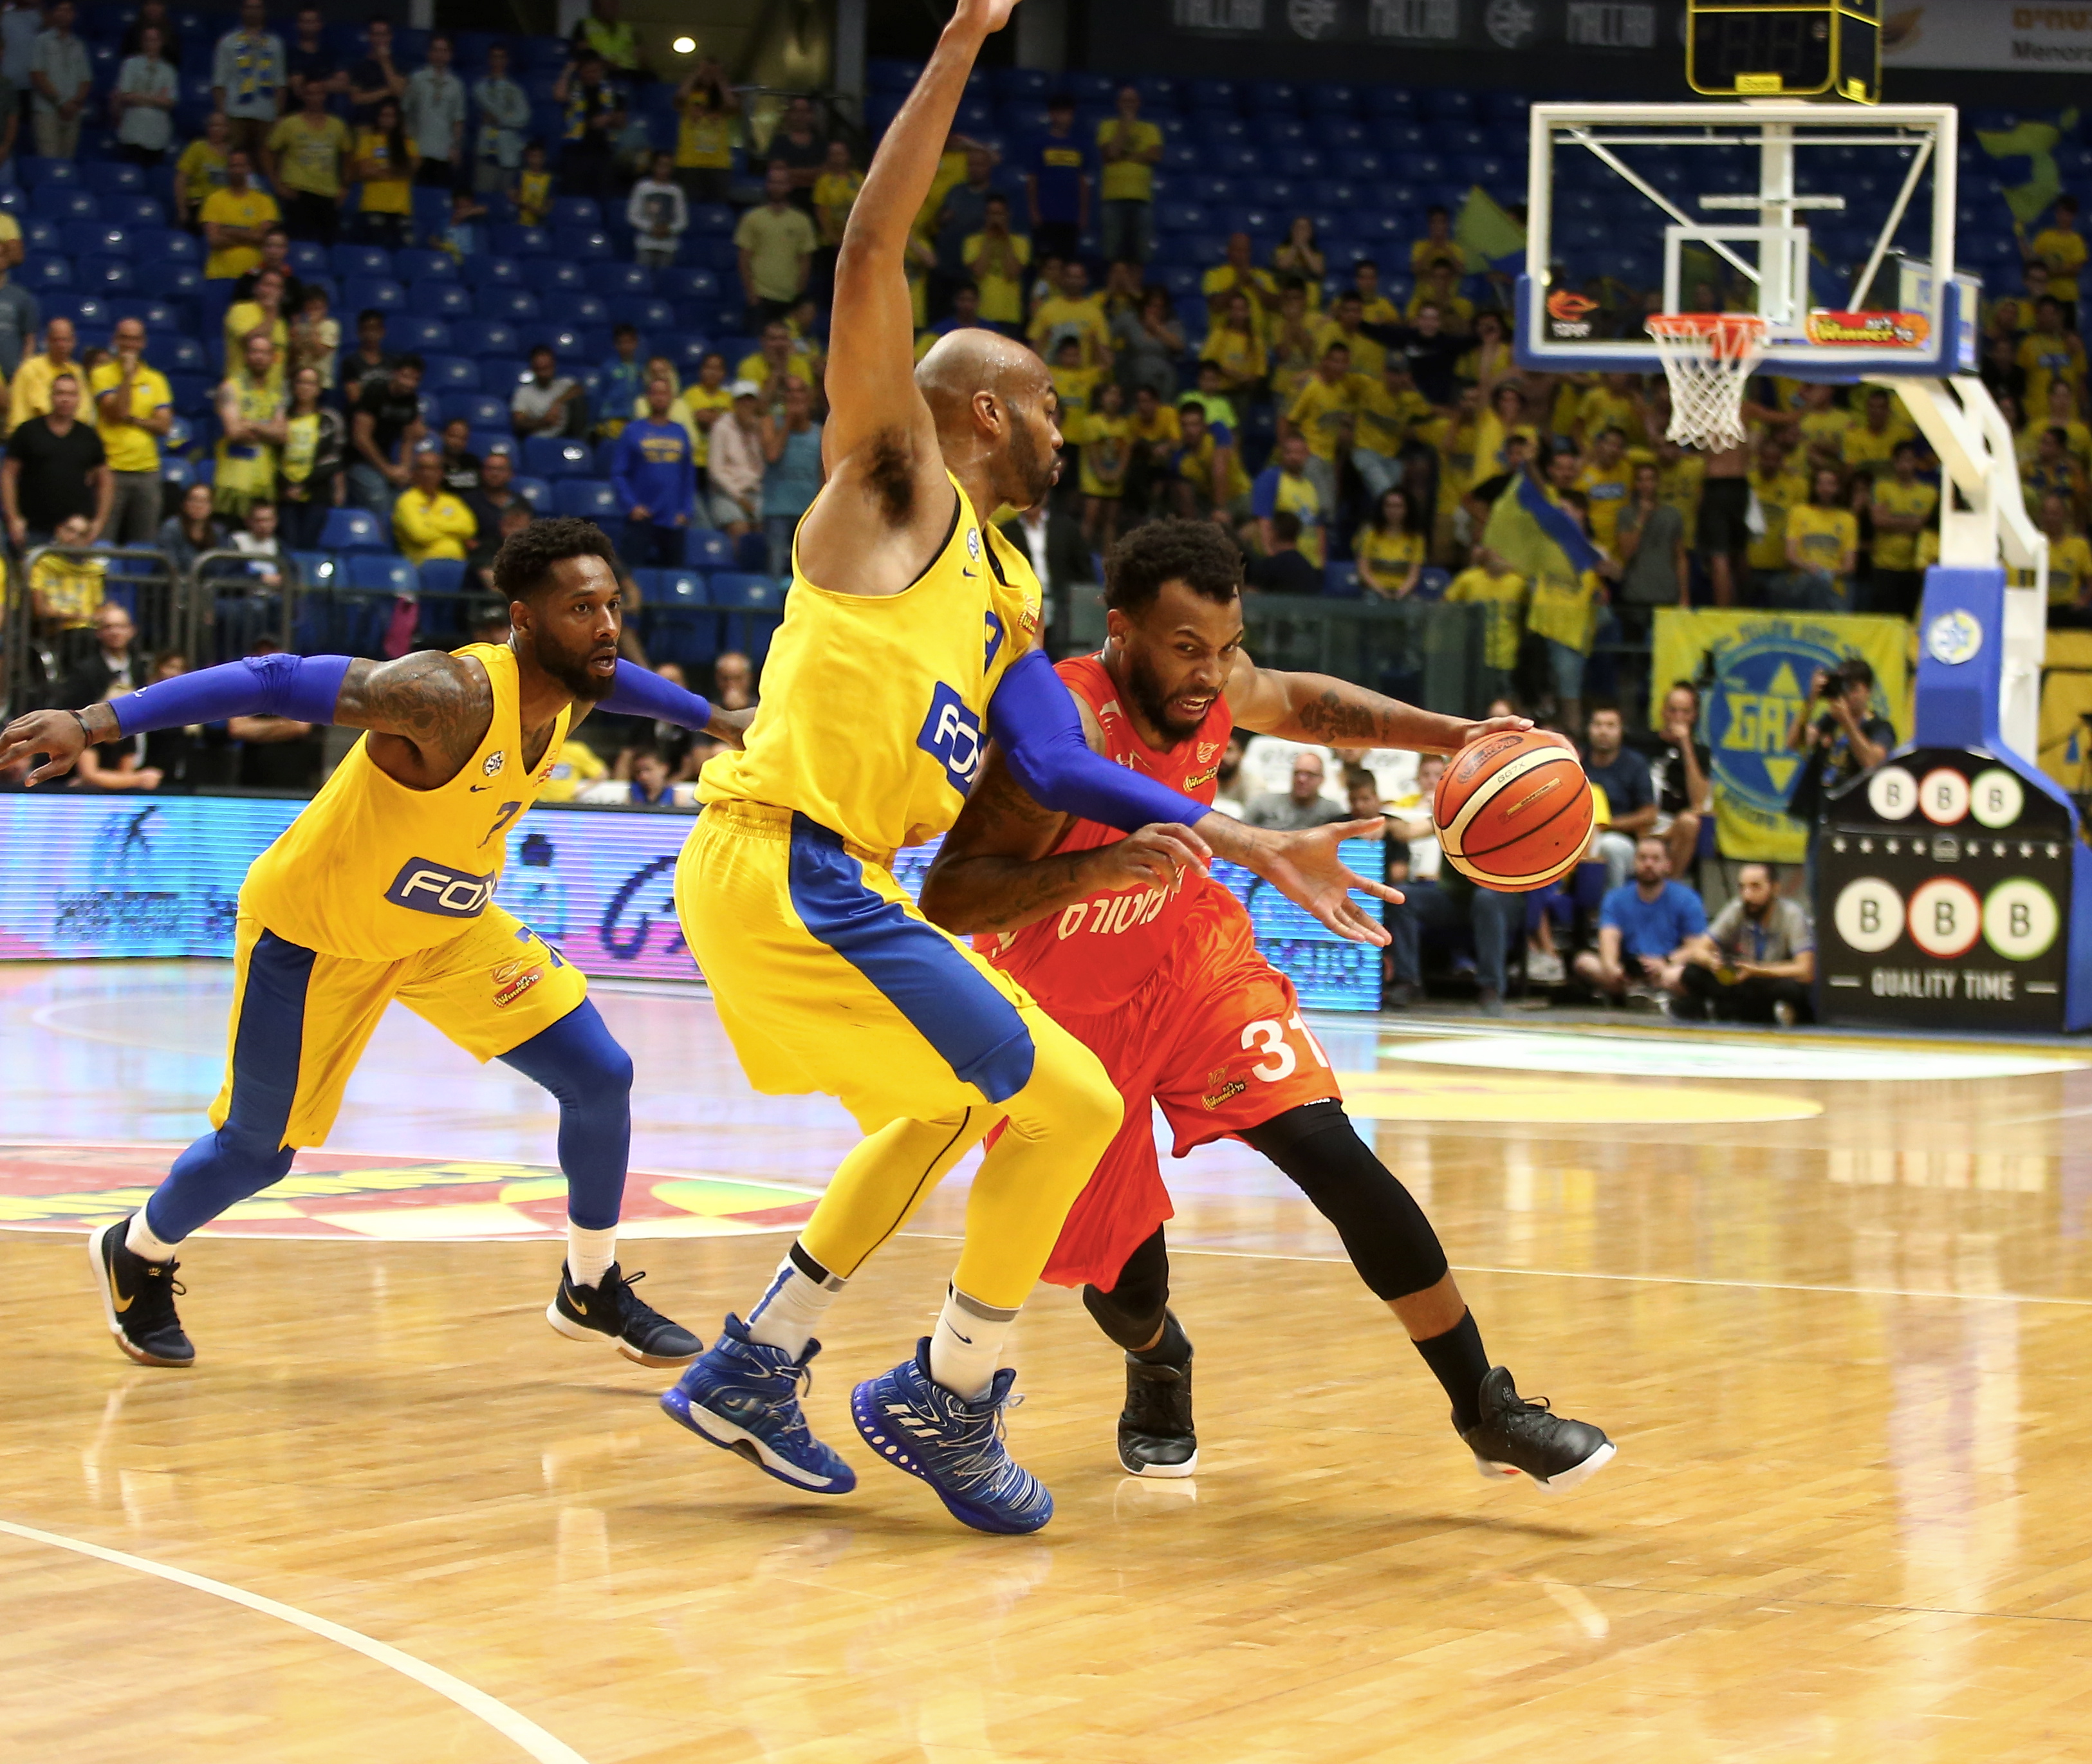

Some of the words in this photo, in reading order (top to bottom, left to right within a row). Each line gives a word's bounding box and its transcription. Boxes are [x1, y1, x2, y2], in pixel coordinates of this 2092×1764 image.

[401, 870, 496, 911] FOX
[498, 979, 530, 1005] Winner
[1871, 968, 1958, 999] QUALITY
[1962, 970, 2017, 1001] TIME
[1241, 1010, 1329, 1083] 31
[1207, 1088, 1236, 1107] Winner
